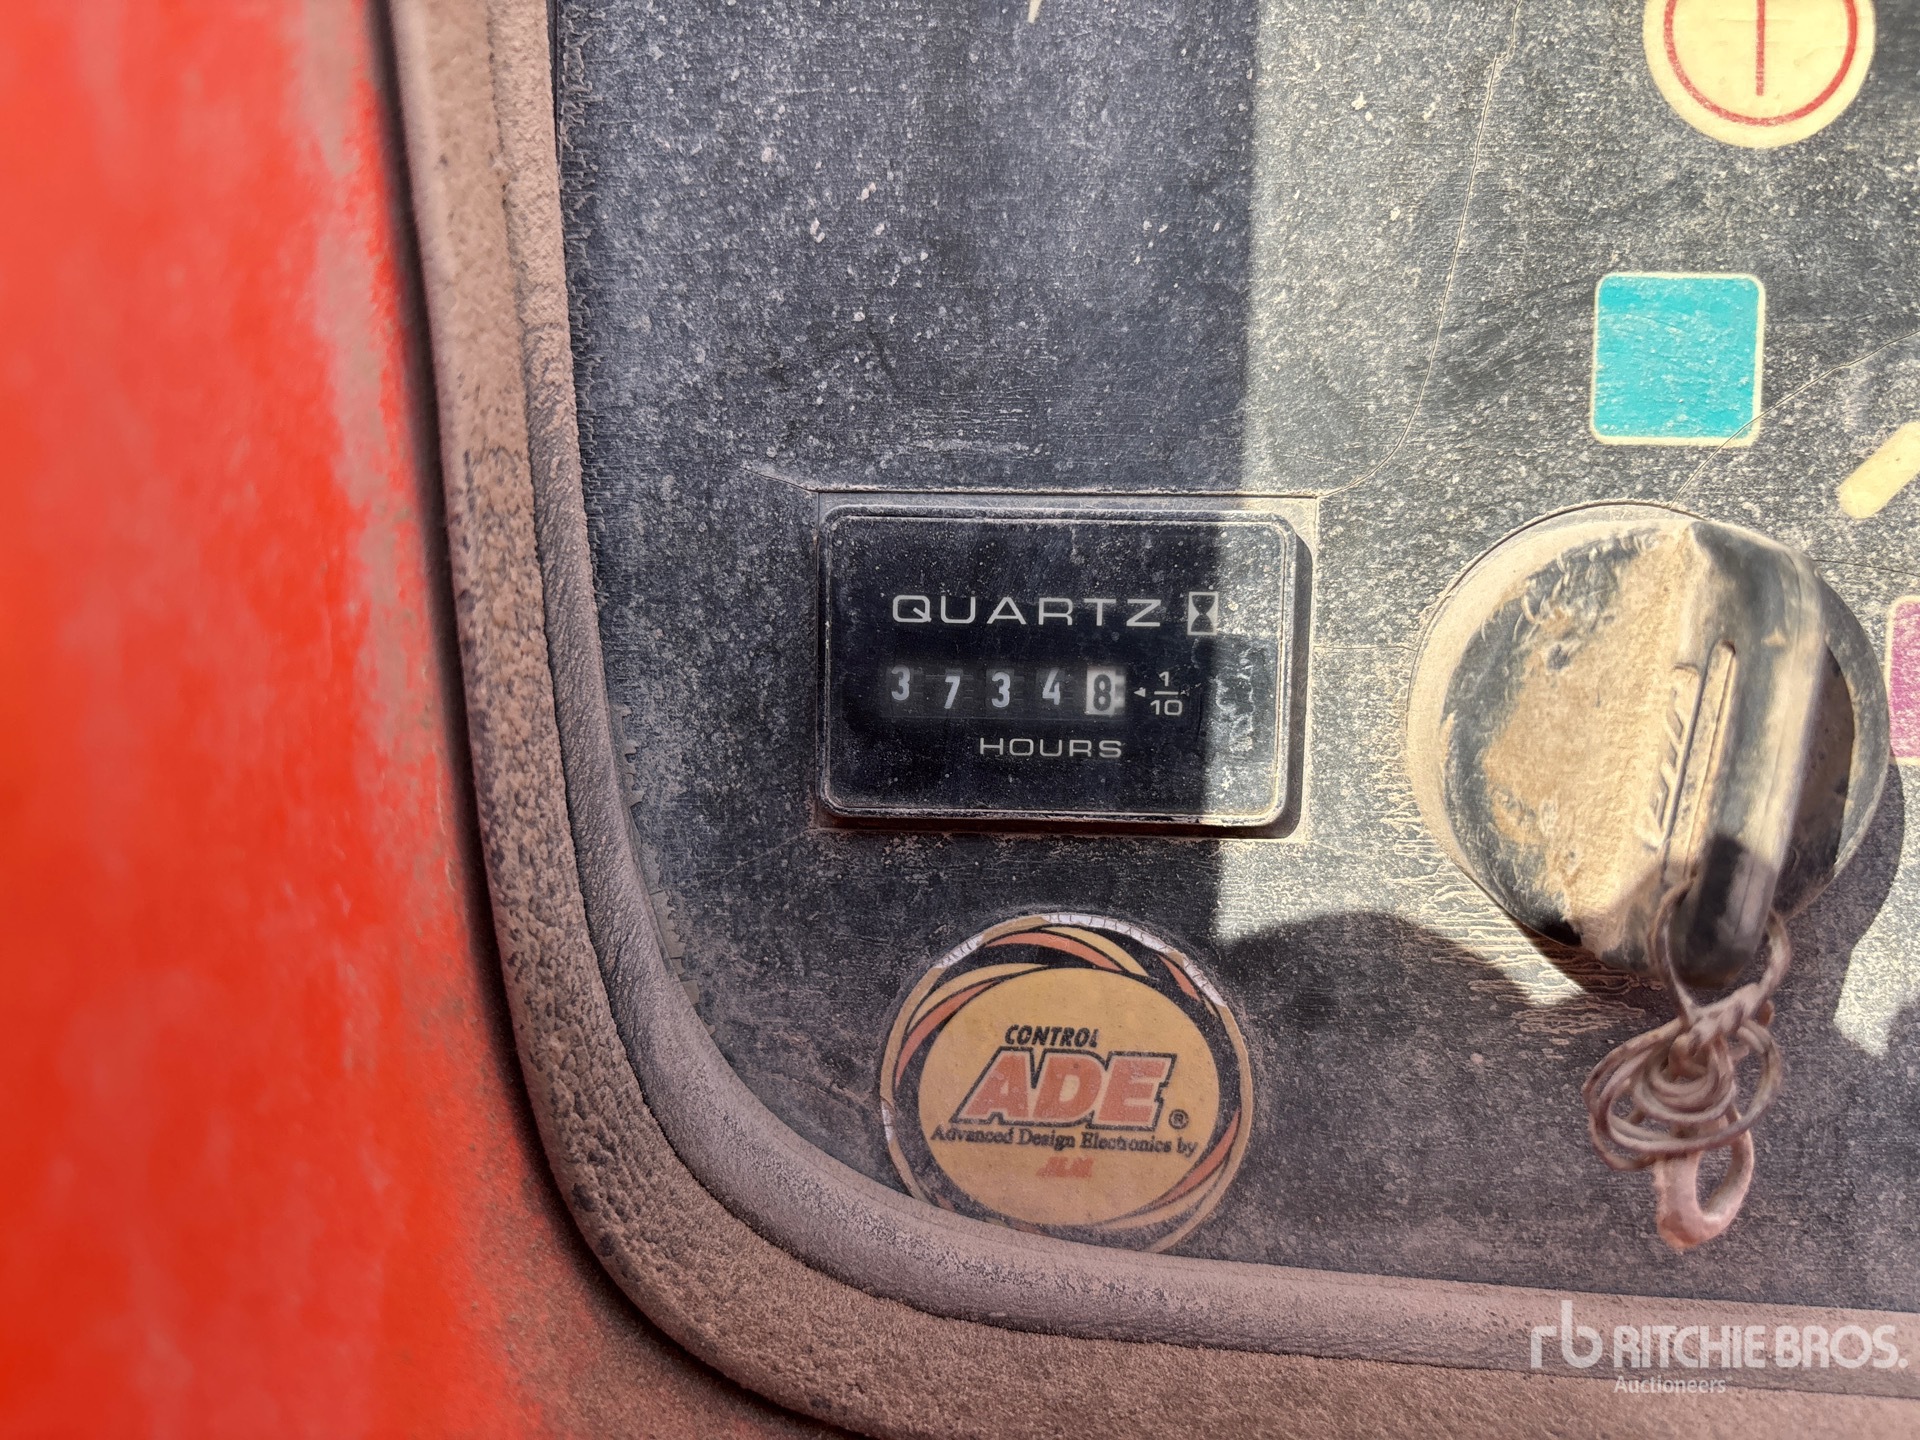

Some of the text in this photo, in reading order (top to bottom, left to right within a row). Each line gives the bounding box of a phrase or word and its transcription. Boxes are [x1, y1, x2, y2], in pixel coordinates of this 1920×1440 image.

[892, 594, 1162, 627] QUARTZ
[979, 737, 1122, 758] HOURS
[1004, 1024, 1099, 1048] CONTROL
[950, 1046, 1177, 1131] ADE
[930, 1123, 1199, 1158] Advanced Design Electronics by
